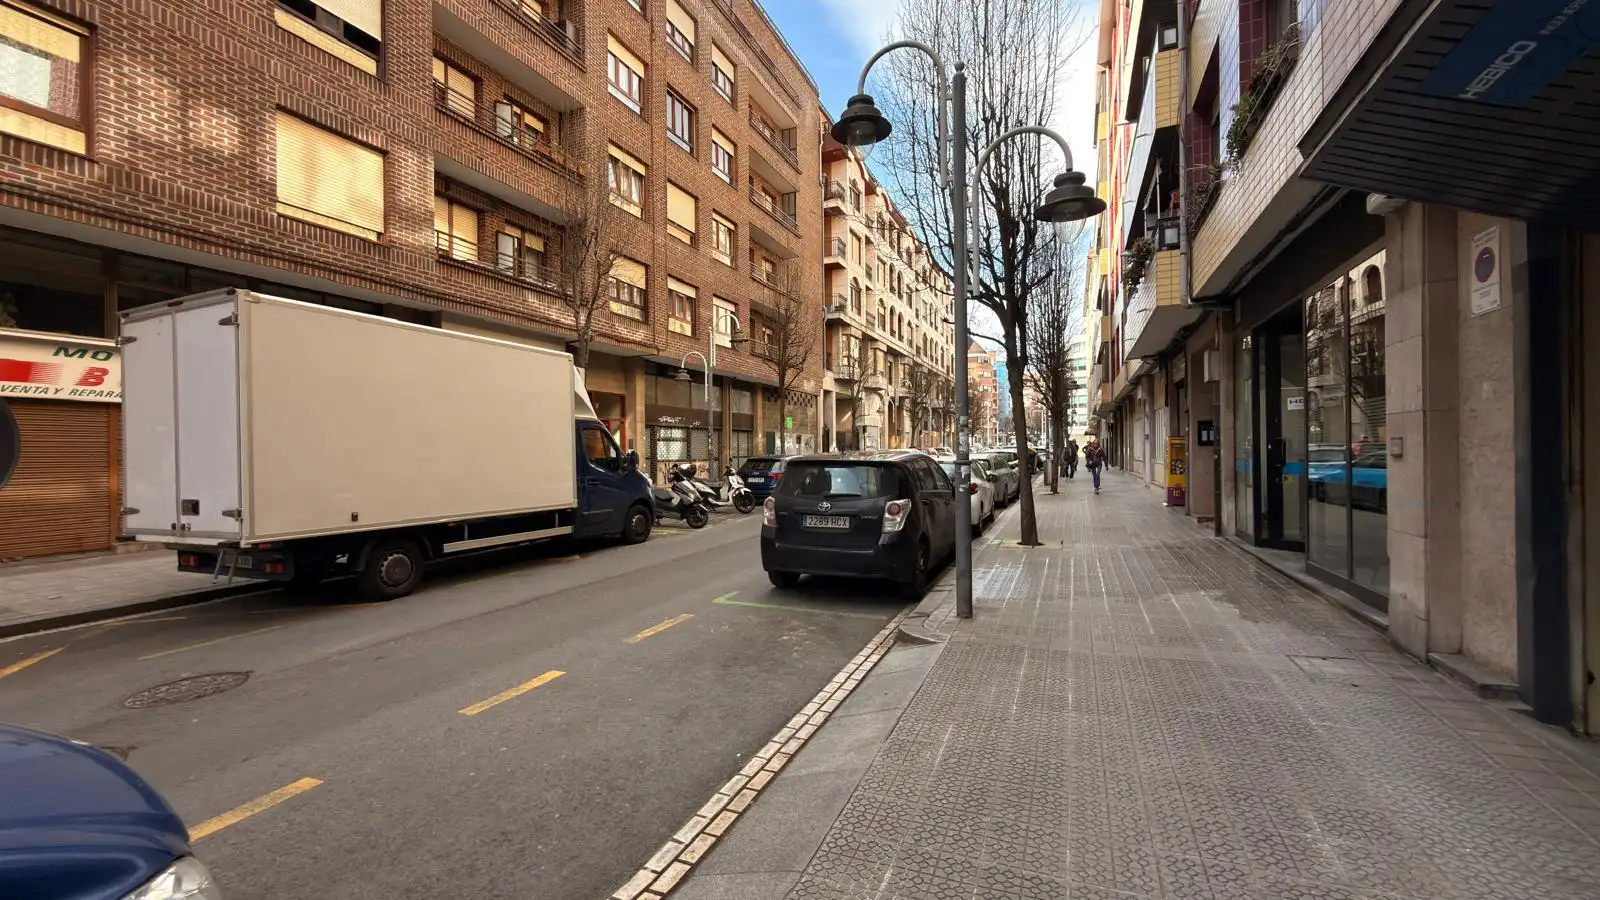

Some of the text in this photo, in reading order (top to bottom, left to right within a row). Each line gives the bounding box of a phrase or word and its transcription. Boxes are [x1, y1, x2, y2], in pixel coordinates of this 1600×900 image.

[1458, 40, 1538, 99] HEBICO
[0, 384, 48, 395] VENTA
[52, 387, 64, 396] Y
[808, 516, 848, 527] 2289 HCX
